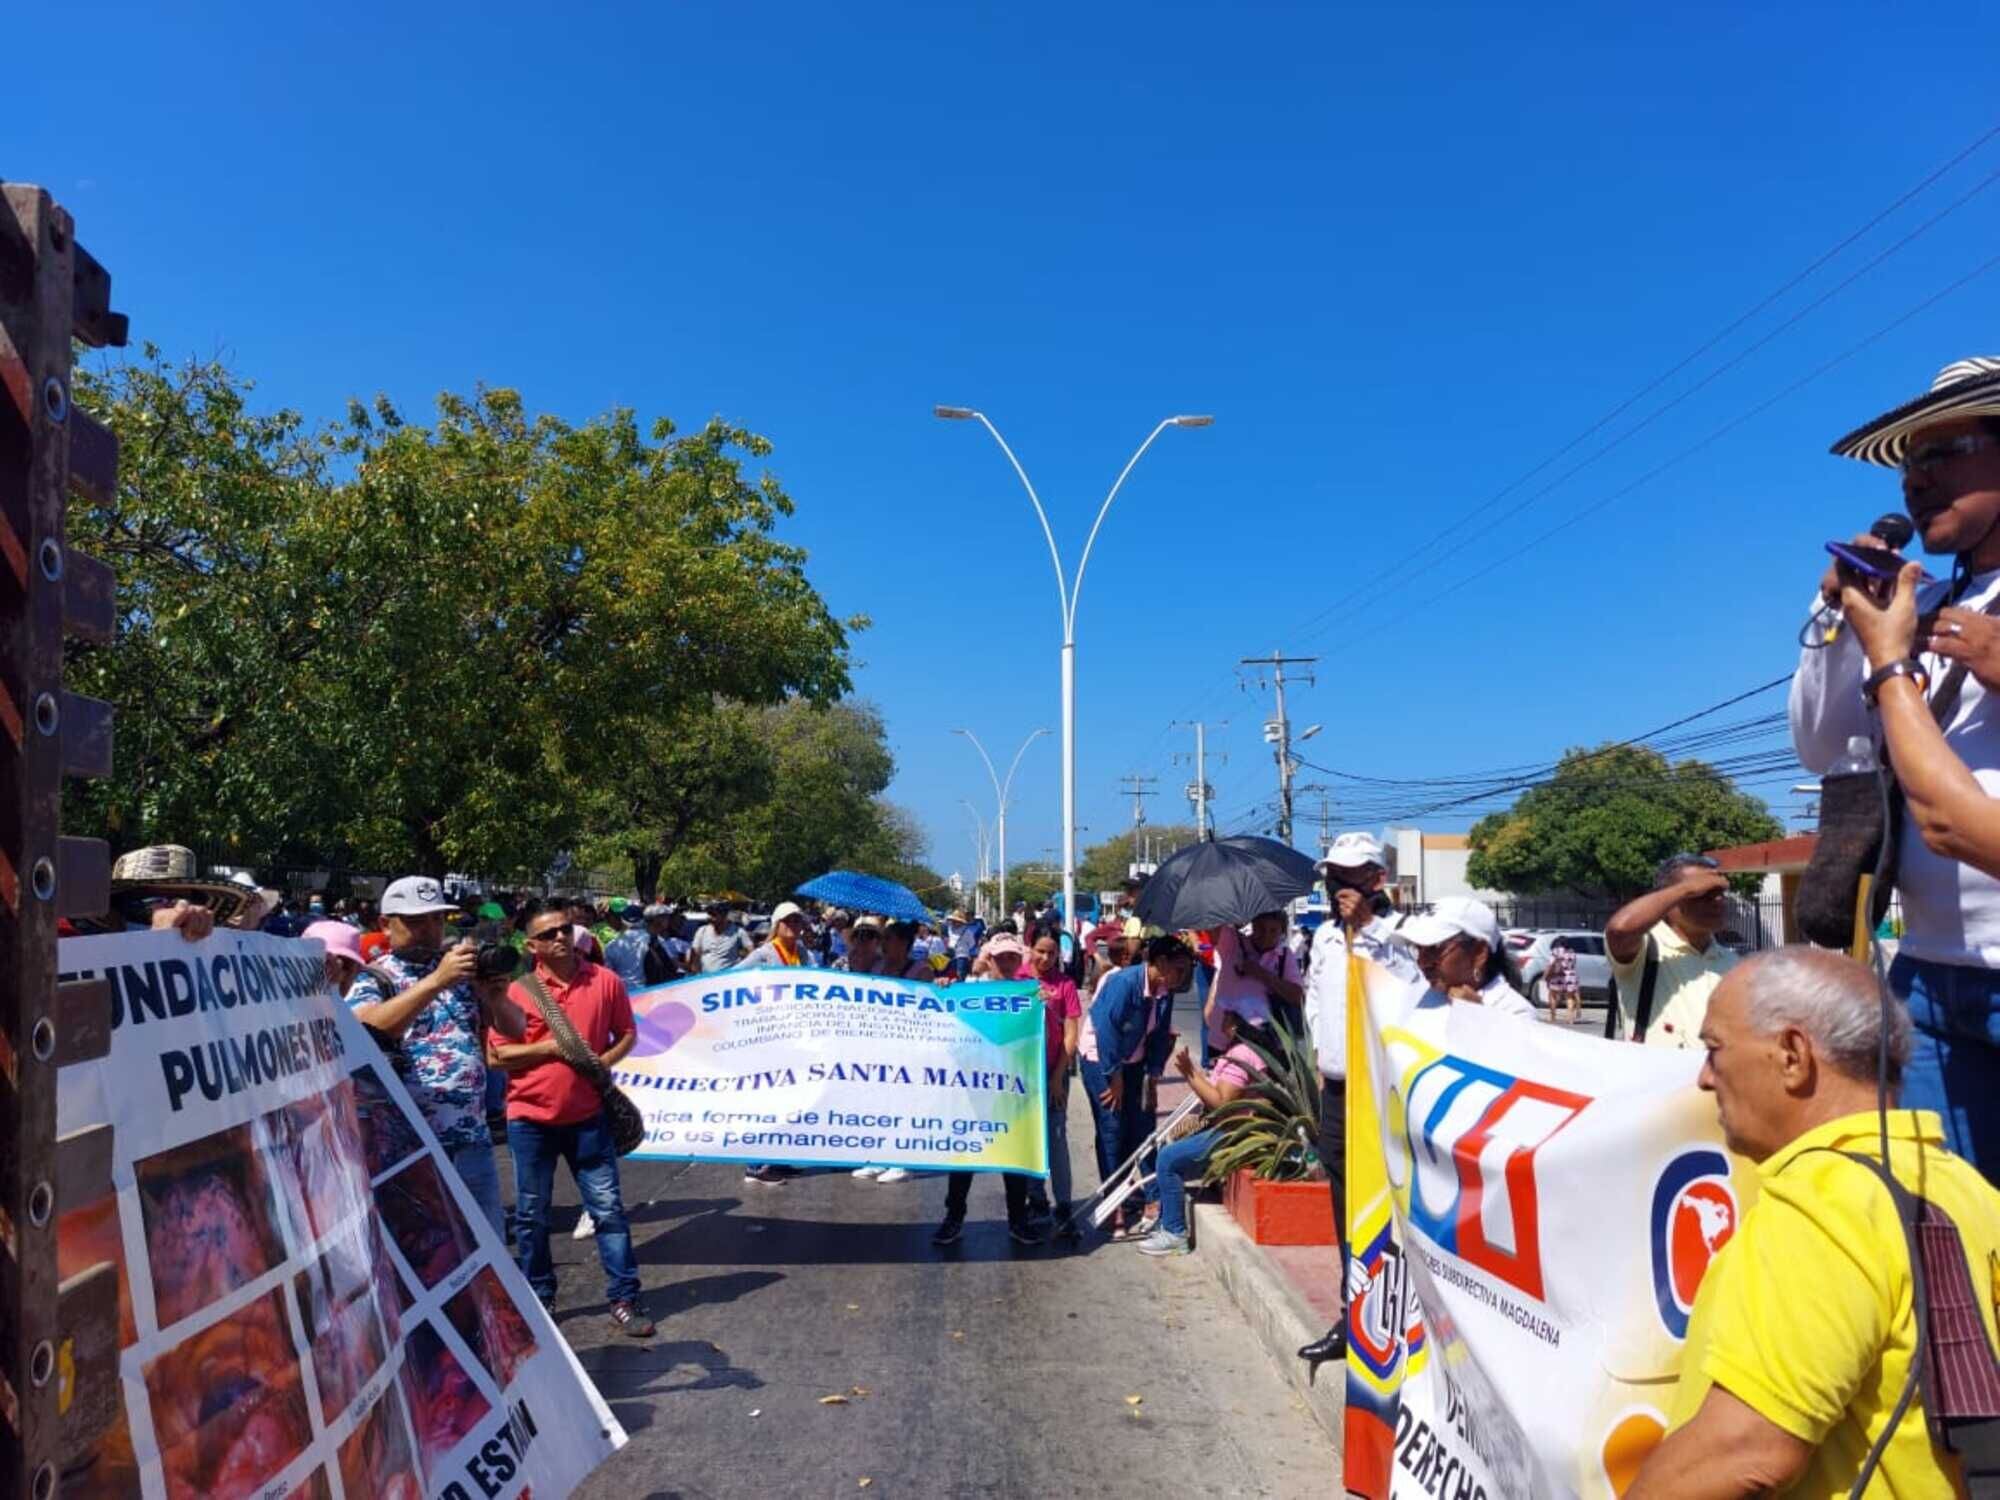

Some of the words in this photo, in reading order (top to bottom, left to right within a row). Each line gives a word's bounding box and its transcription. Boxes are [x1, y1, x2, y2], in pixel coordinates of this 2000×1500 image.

[57, 941, 278, 1031] UNDACIÓN
[826, 1020, 852, 1030] DEL
[712, 1031, 802, 1053] COLOMBIANO
[810, 1029, 828, 1038] DE
[160, 1021, 312, 1112] PULMONES
[807, 1062, 912, 1084] SANTA
[922, 1067, 1027, 1095] MARTA
[701, 1109, 777, 1125] forma
[786, 1110, 819, 1126] de
[828, 1109, 903, 1128] hacer
[910, 1117, 943, 1132] un
[951, 1118, 1009, 1136] gran
[722, 1128, 887, 1149] permanecer
[895, 1135, 994, 1154] unidos"
[1499, 1298, 1561, 1348] MAGDALENA
